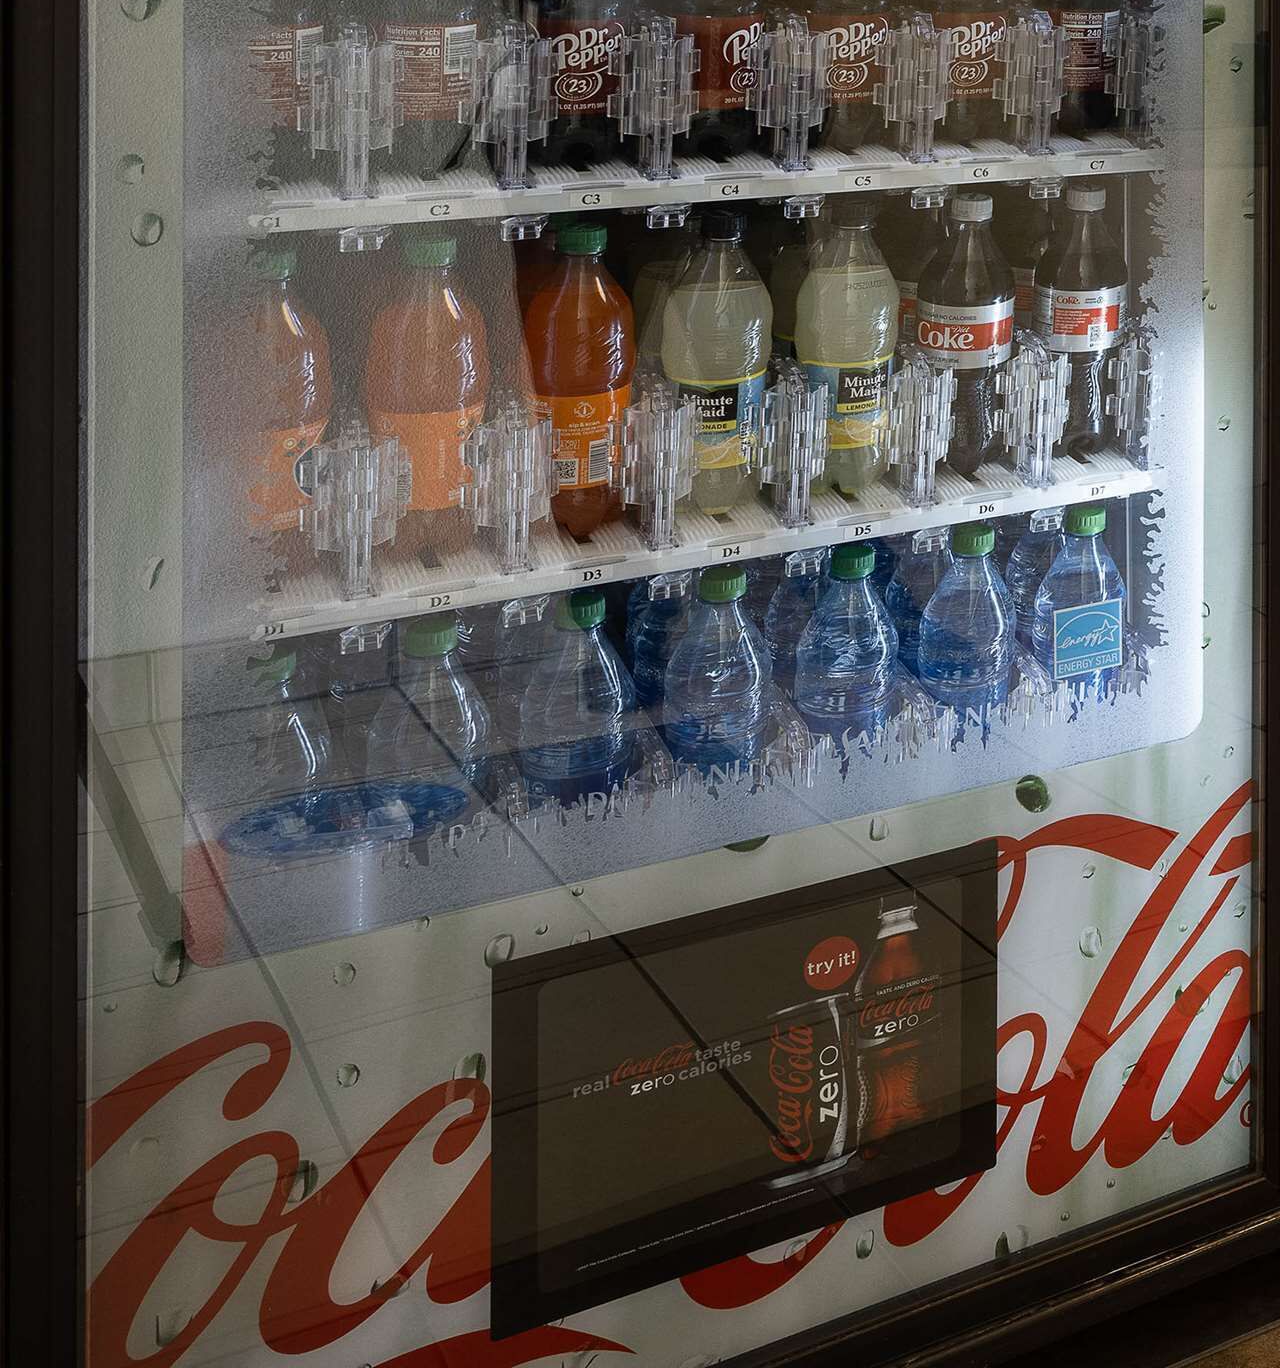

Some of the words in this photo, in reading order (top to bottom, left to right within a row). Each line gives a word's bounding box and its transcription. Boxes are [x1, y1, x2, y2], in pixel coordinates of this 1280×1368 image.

[580, 26, 609, 49] Dr
[850, 21, 876, 44] Dr
[970, 21, 995, 43] Dr
[1086, 28, 1102, 38] 240
[551, 33, 625, 69] Pepper
[827, 27, 888, 60] Pepper
[949, 25, 1004, 59] Pepper
[270, 50, 292, 62] 240
[419, 46, 441, 57] 240
[972, 167, 989, 178] C6
[1089, 159, 1105, 170] C7
[721, 184, 740, 196] C4
[854, 175, 872, 187] C5
[581, 193, 601, 205] C3
[429, 204, 451, 216] C2
[918, 321, 976, 350] Coke
[844, 373, 887, 388] Minute
[978, 503, 994, 514] D6
[854, 525, 872, 536] D5
[722, 546, 741, 558] D4
[582, 569, 603, 582] D3
[430, 595, 451, 608] D2
[1058, 657, 1095, 674] ENERGY
[1095, 652, 1118, 666] STAR
[806, 956, 835, 977] try
[837, 950, 857, 969] it!
[859, 987, 936, 1029] Coca-Cola
[874, 1013, 920, 1037] zero
[572, 1076, 611, 1099] real
[611, 1041, 696, 1087] Coca-Cola
[694, 1039, 742, 1063] taste
[629, 1073, 675, 1097] zero
[678, 1050, 753, 1082] calories
[768, 1022, 814, 1164] Coca-Cola
[818, 1044, 839, 1124] zero
